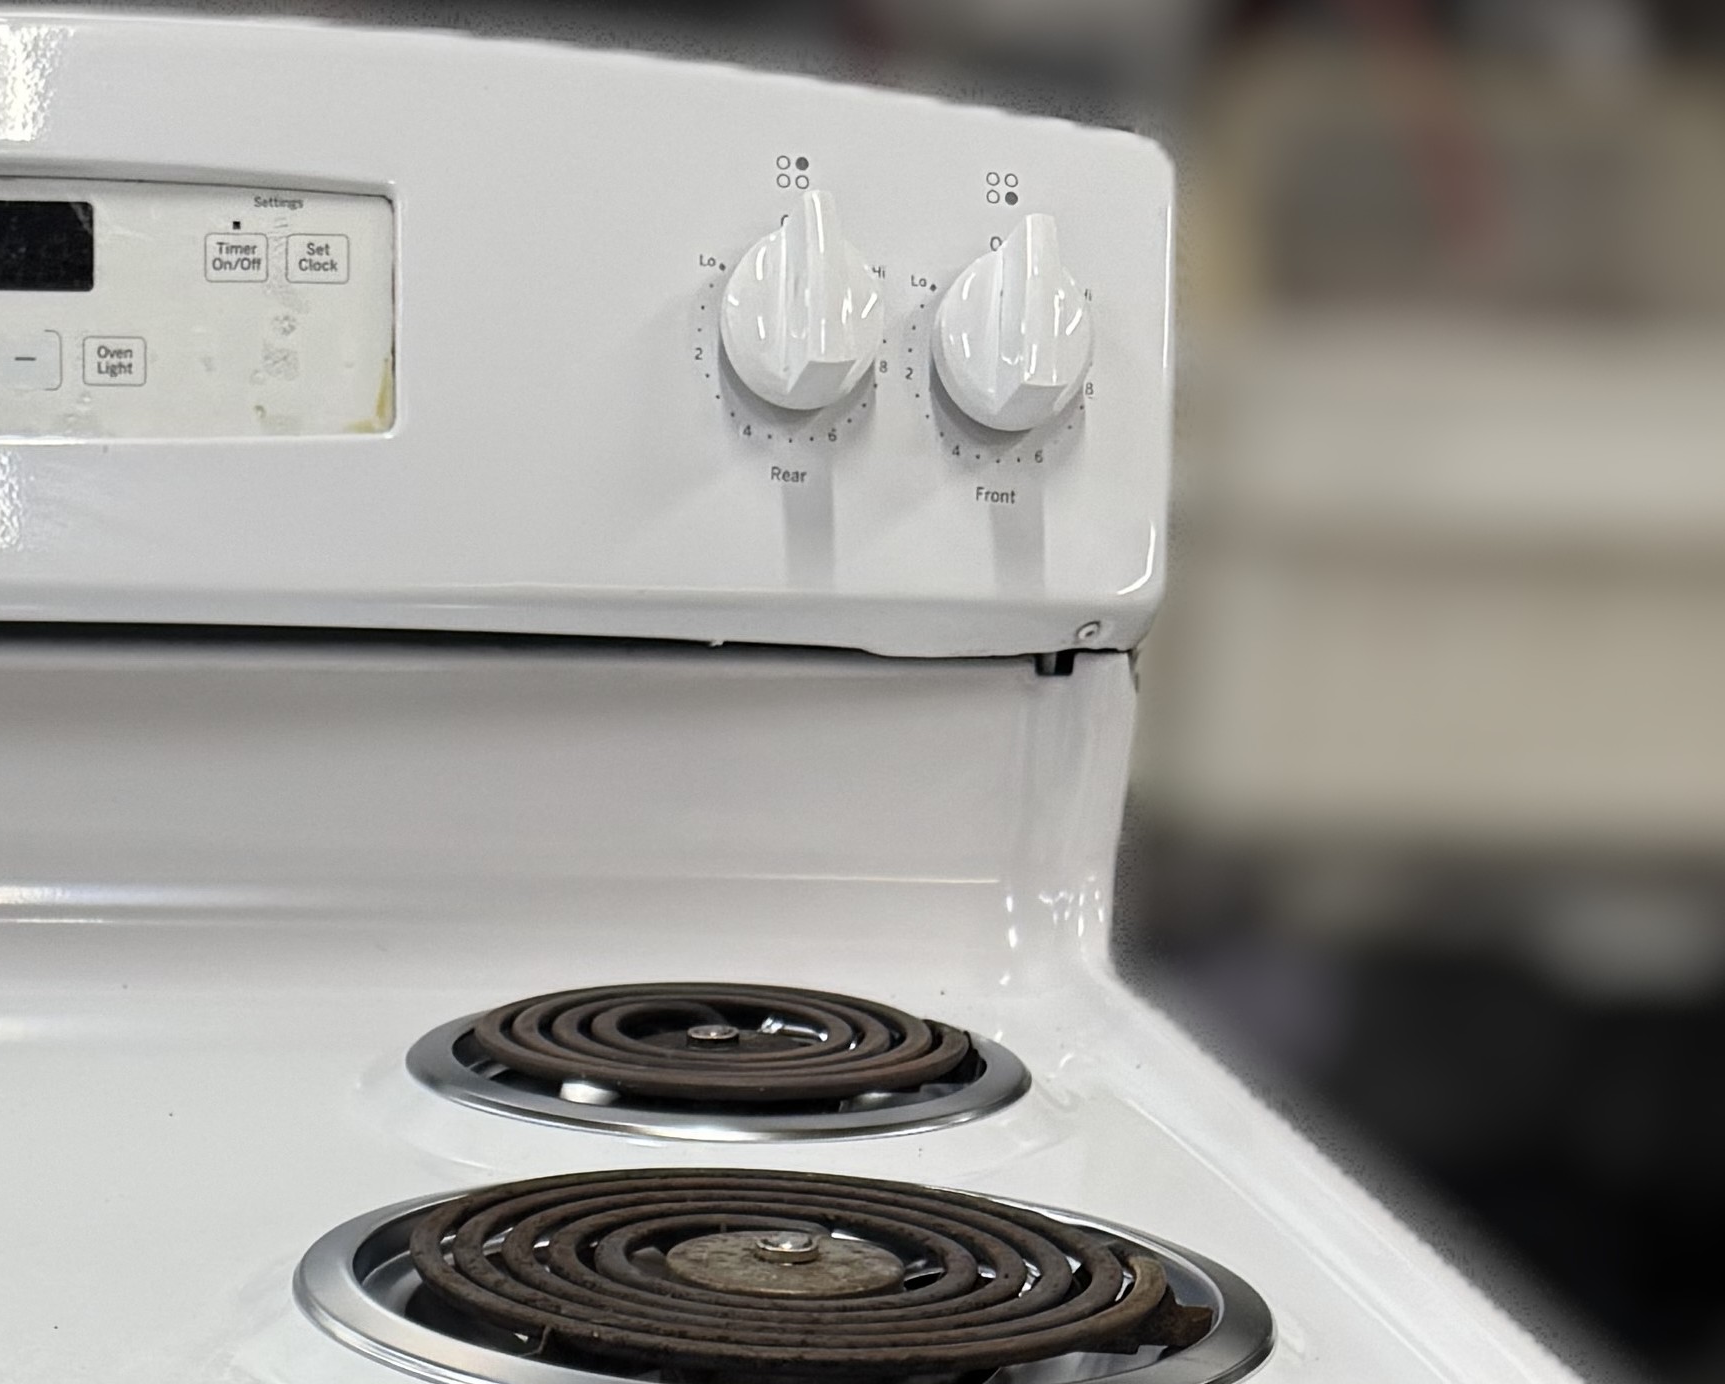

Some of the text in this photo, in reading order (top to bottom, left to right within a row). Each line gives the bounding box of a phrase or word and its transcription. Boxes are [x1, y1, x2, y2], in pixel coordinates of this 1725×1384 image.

[254, 196, 304, 210] Settings
[216, 241, 257, 255] Timer
[306, 242, 331, 256] Set
[212, 257, 262, 272] On/Off
[298, 258, 338, 273] Clock
[699, 254, 716, 267] Lo
[911, 275, 927, 288] Lo
[97, 345, 133, 359] Oven
[695, 347, 703, 360] 2
[97, 361, 133, 377] Light
[879, 361, 888, 373] 8
[905, 367, 914, 380] 2
[742, 424, 752, 437] 4
[828, 428, 837, 442] 6
[952, 445, 960, 457] 4
[1035, 450, 1044, 463] 6
[771, 466, 807, 483] Rear
[976, 486, 1016, 504] Front
